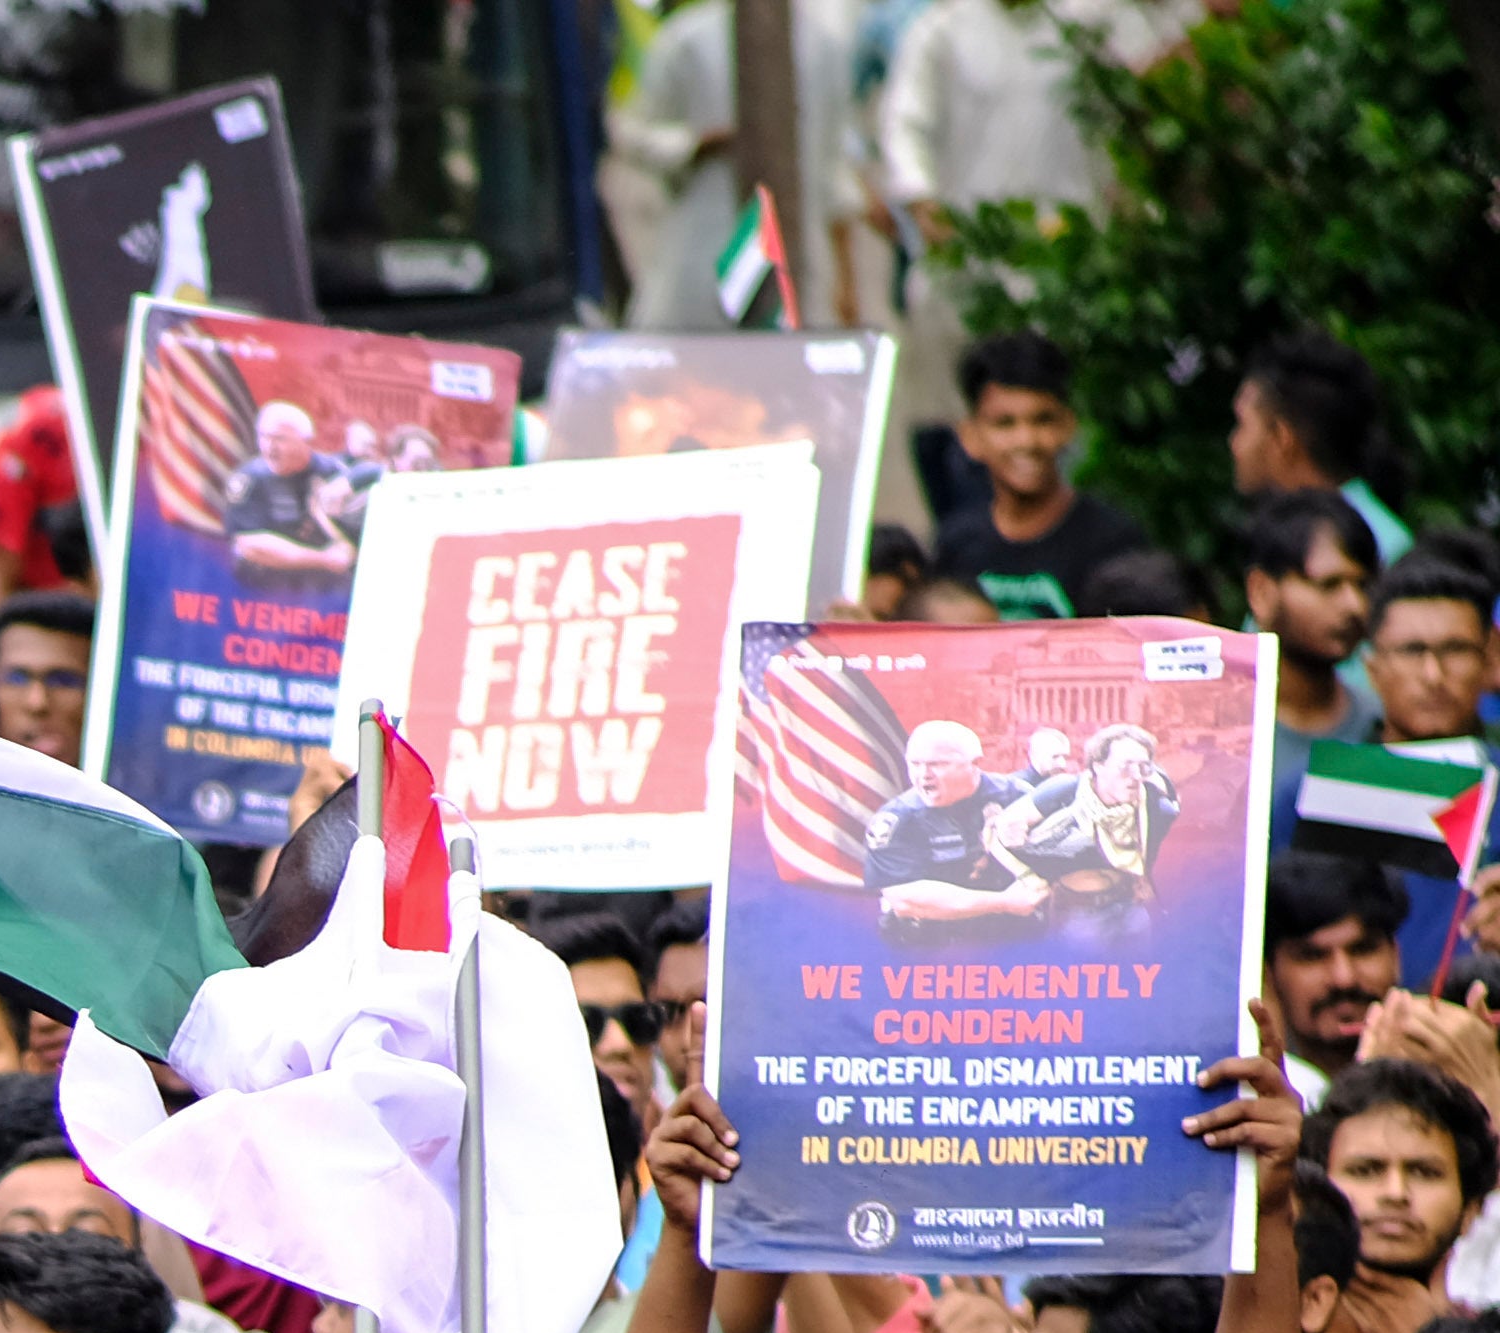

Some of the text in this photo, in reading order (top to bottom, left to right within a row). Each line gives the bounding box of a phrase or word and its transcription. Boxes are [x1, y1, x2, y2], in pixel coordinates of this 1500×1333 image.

[467, 541, 687, 626] CEASE
[172, 590, 219, 624] WE
[134, 657, 174, 687] THE
[179, 662, 282, 700] FORCEFUL
[456, 613, 678, 726] FIRE
[176, 697, 334, 738] OF THE ENCAM
[165, 726, 188, 750] IN
[193, 730, 296, 765] COLUMBIA
[443, 716, 662, 815] NOW
[801, 964, 1162, 999] WE VEHEMENTLY
[873, 1010, 1083, 1044] CONDEMN
[755, 1055, 1201, 1086] THE FORCEFUL DISMANTLEMENT
[816, 1096, 1135, 1126] OF THE ENCAMPMENTS
[801, 1135, 1148, 1166] IN COLUMBIA UNIVERSITY
[912, 1206, 1013, 1228] বাংলাদেশ
[912, 1231, 1024, 1250] www.bsl.org.bd
